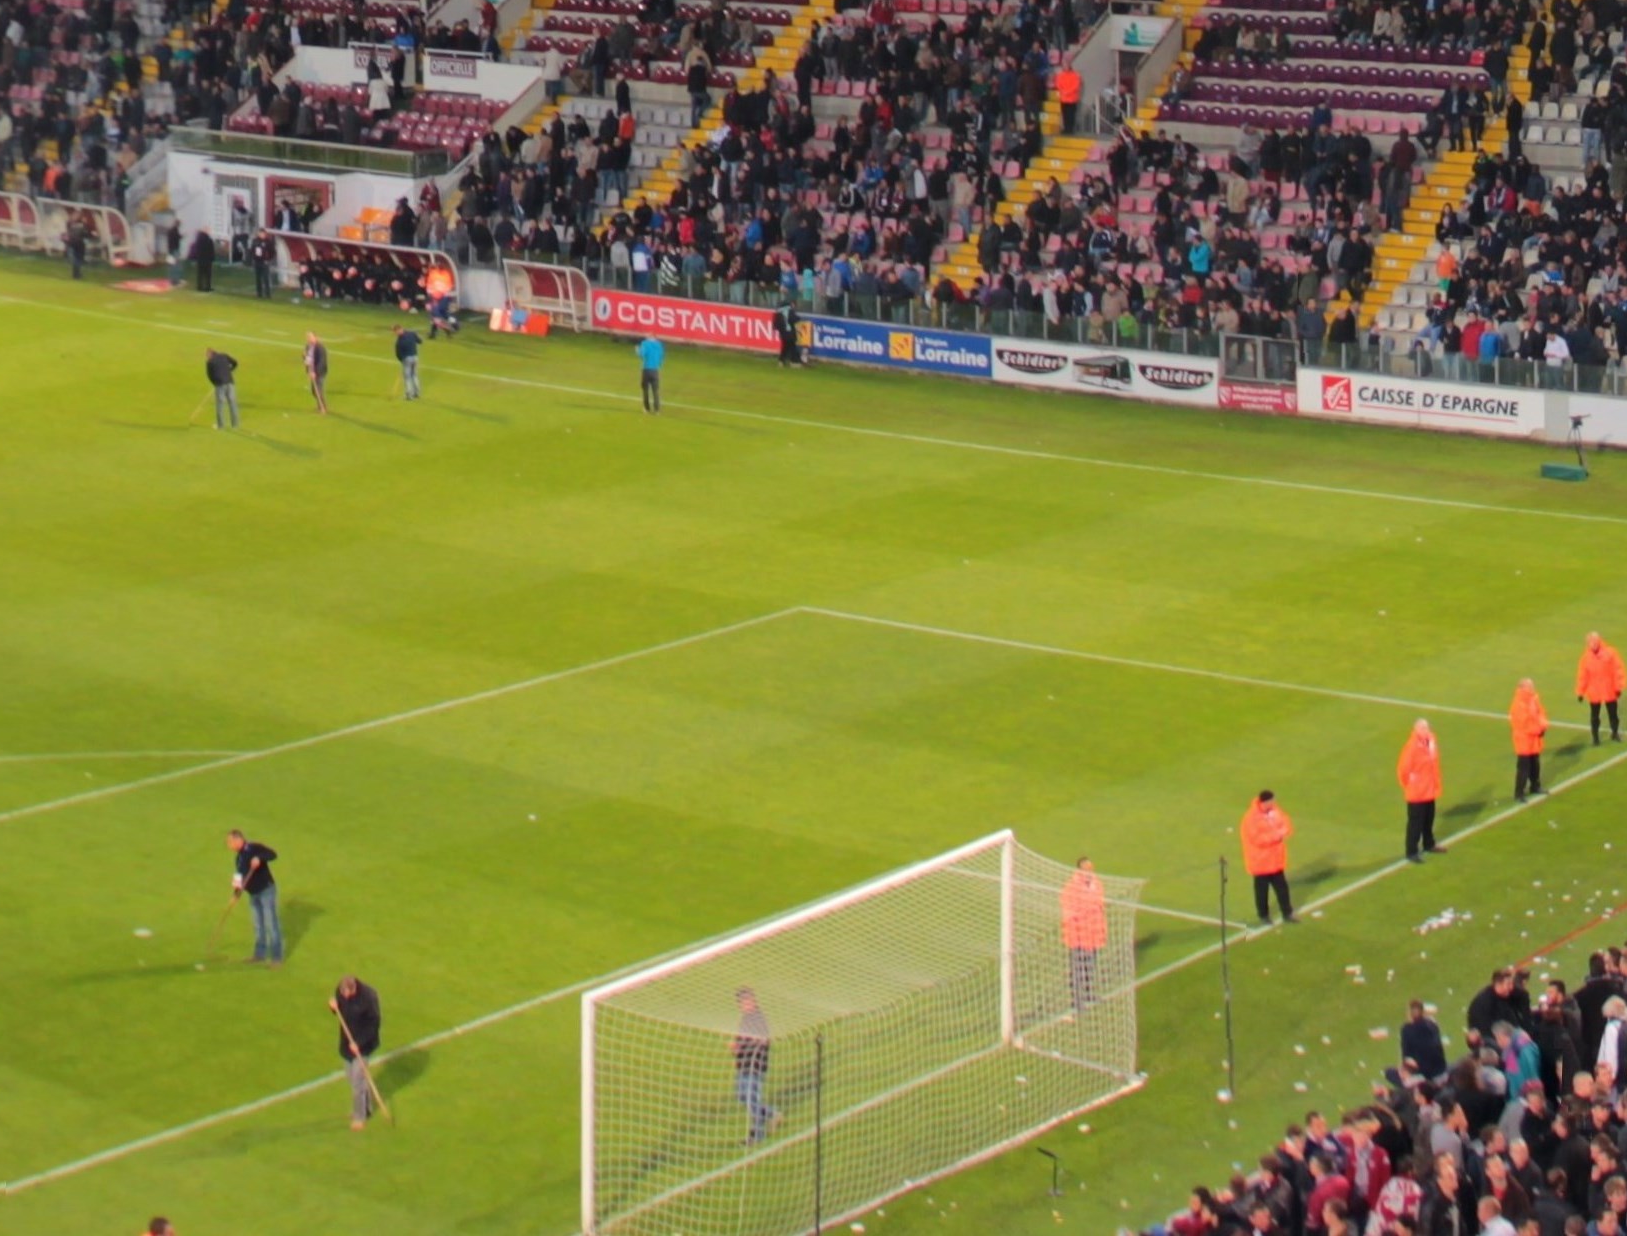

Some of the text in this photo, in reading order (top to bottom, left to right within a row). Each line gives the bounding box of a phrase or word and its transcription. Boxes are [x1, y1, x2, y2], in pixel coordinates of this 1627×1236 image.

[432, 60, 474, 76] OFFICIELLE
[814, 333, 884, 354] Lorraine
[915, 345, 988, 368] Lorraine
[1358, 386, 1519, 417] CAISSE D'EPARGNE
